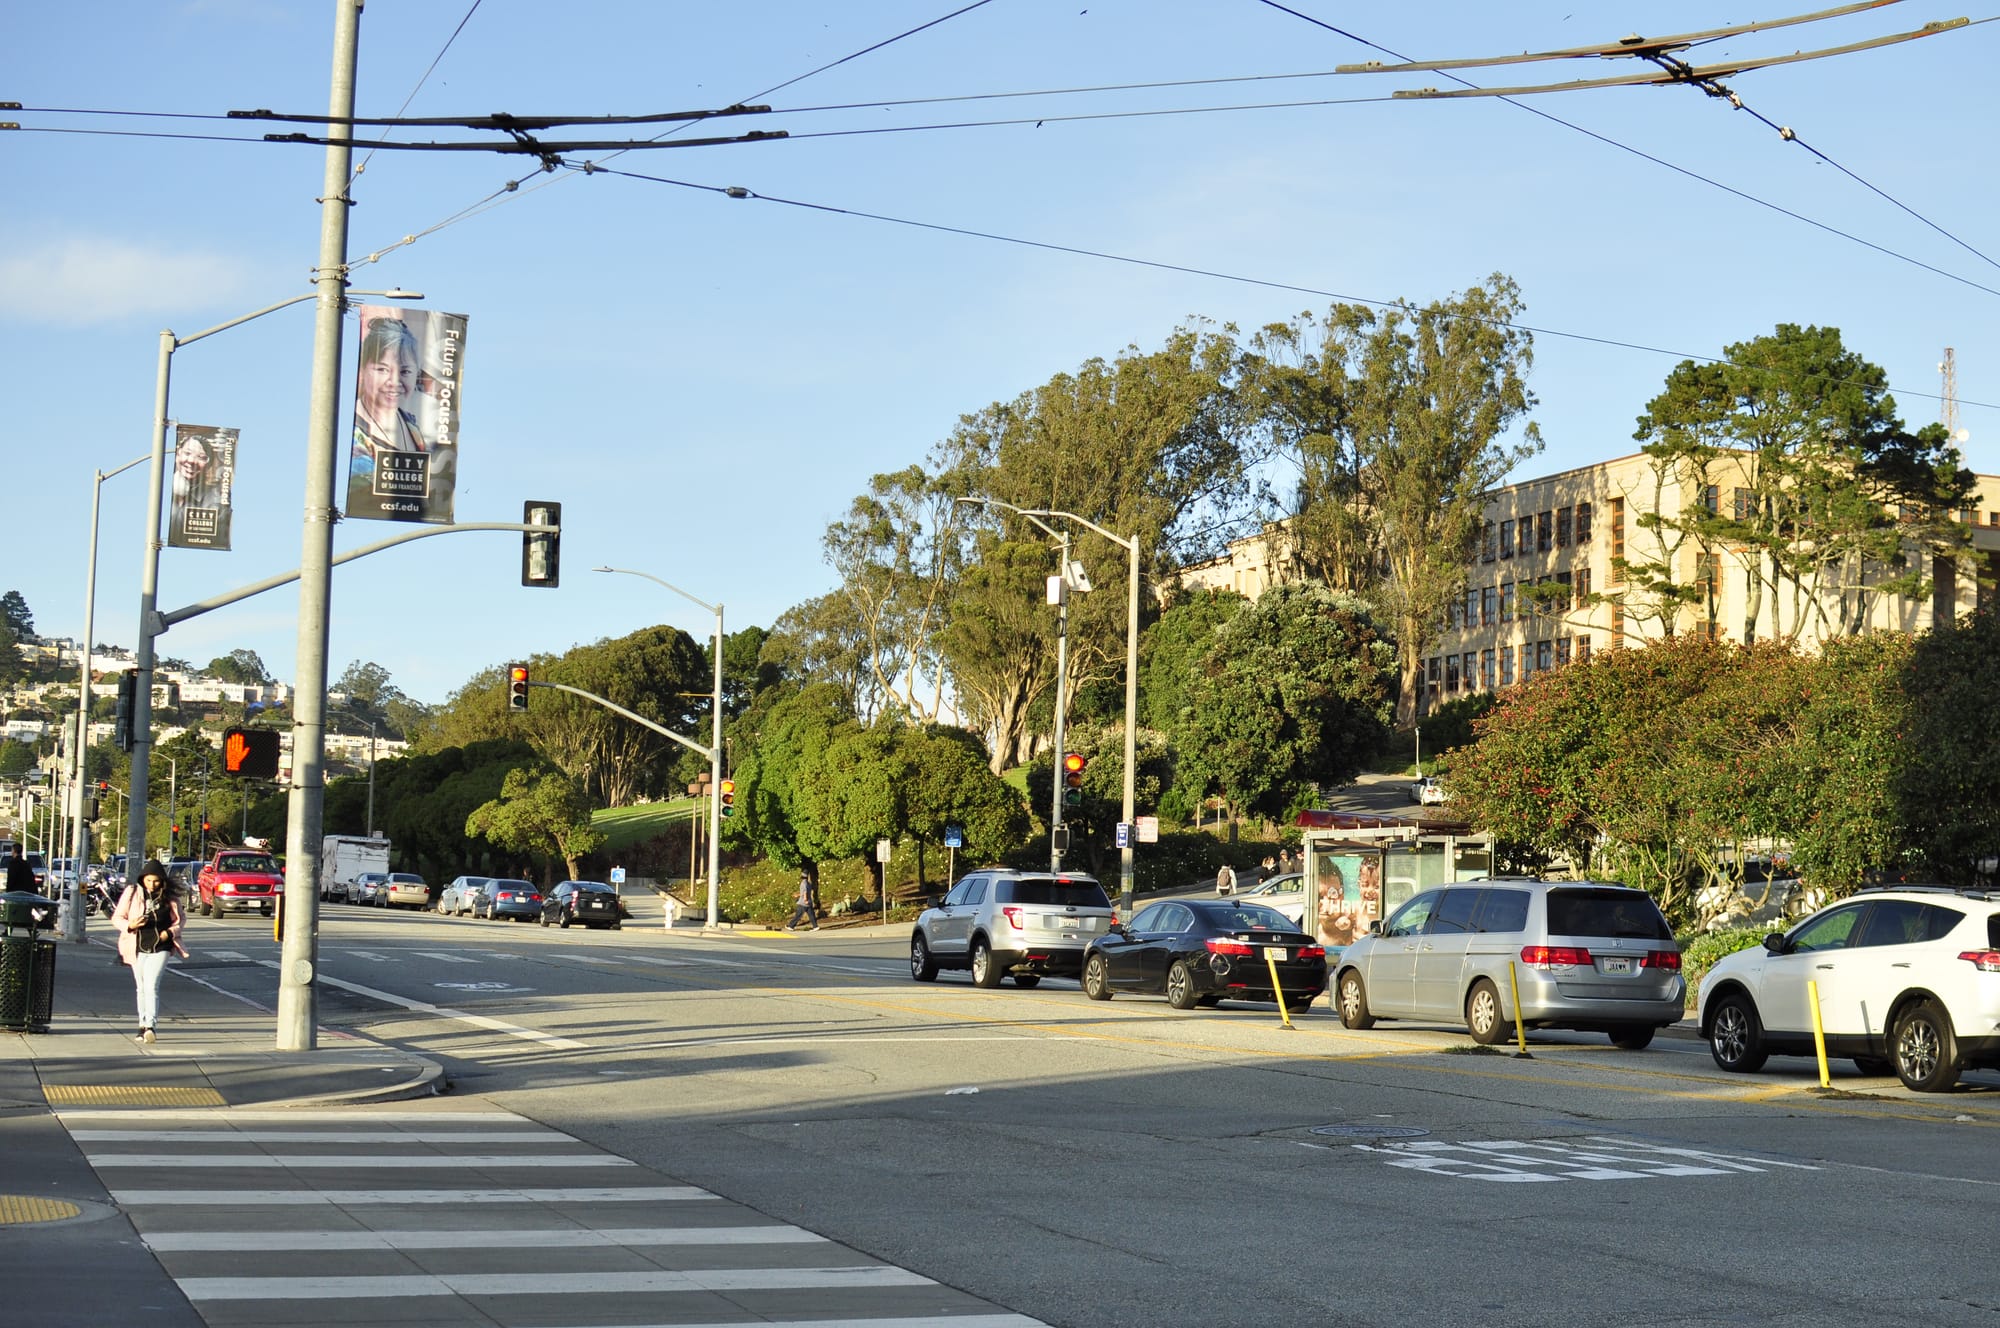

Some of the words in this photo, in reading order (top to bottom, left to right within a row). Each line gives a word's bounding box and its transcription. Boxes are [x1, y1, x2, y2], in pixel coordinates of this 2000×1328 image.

[443, 329, 459, 376] Future
[438, 382, 455, 445] Focused
[224, 437, 235, 465] Future
[383, 457, 424, 469] CITY
[221, 467, 232, 504] Focused
[381, 471, 423, 482] COLLEGE
[381, 502, 419, 512] ccsf.edu
[1320, 899, 1377, 915] THRIVE
